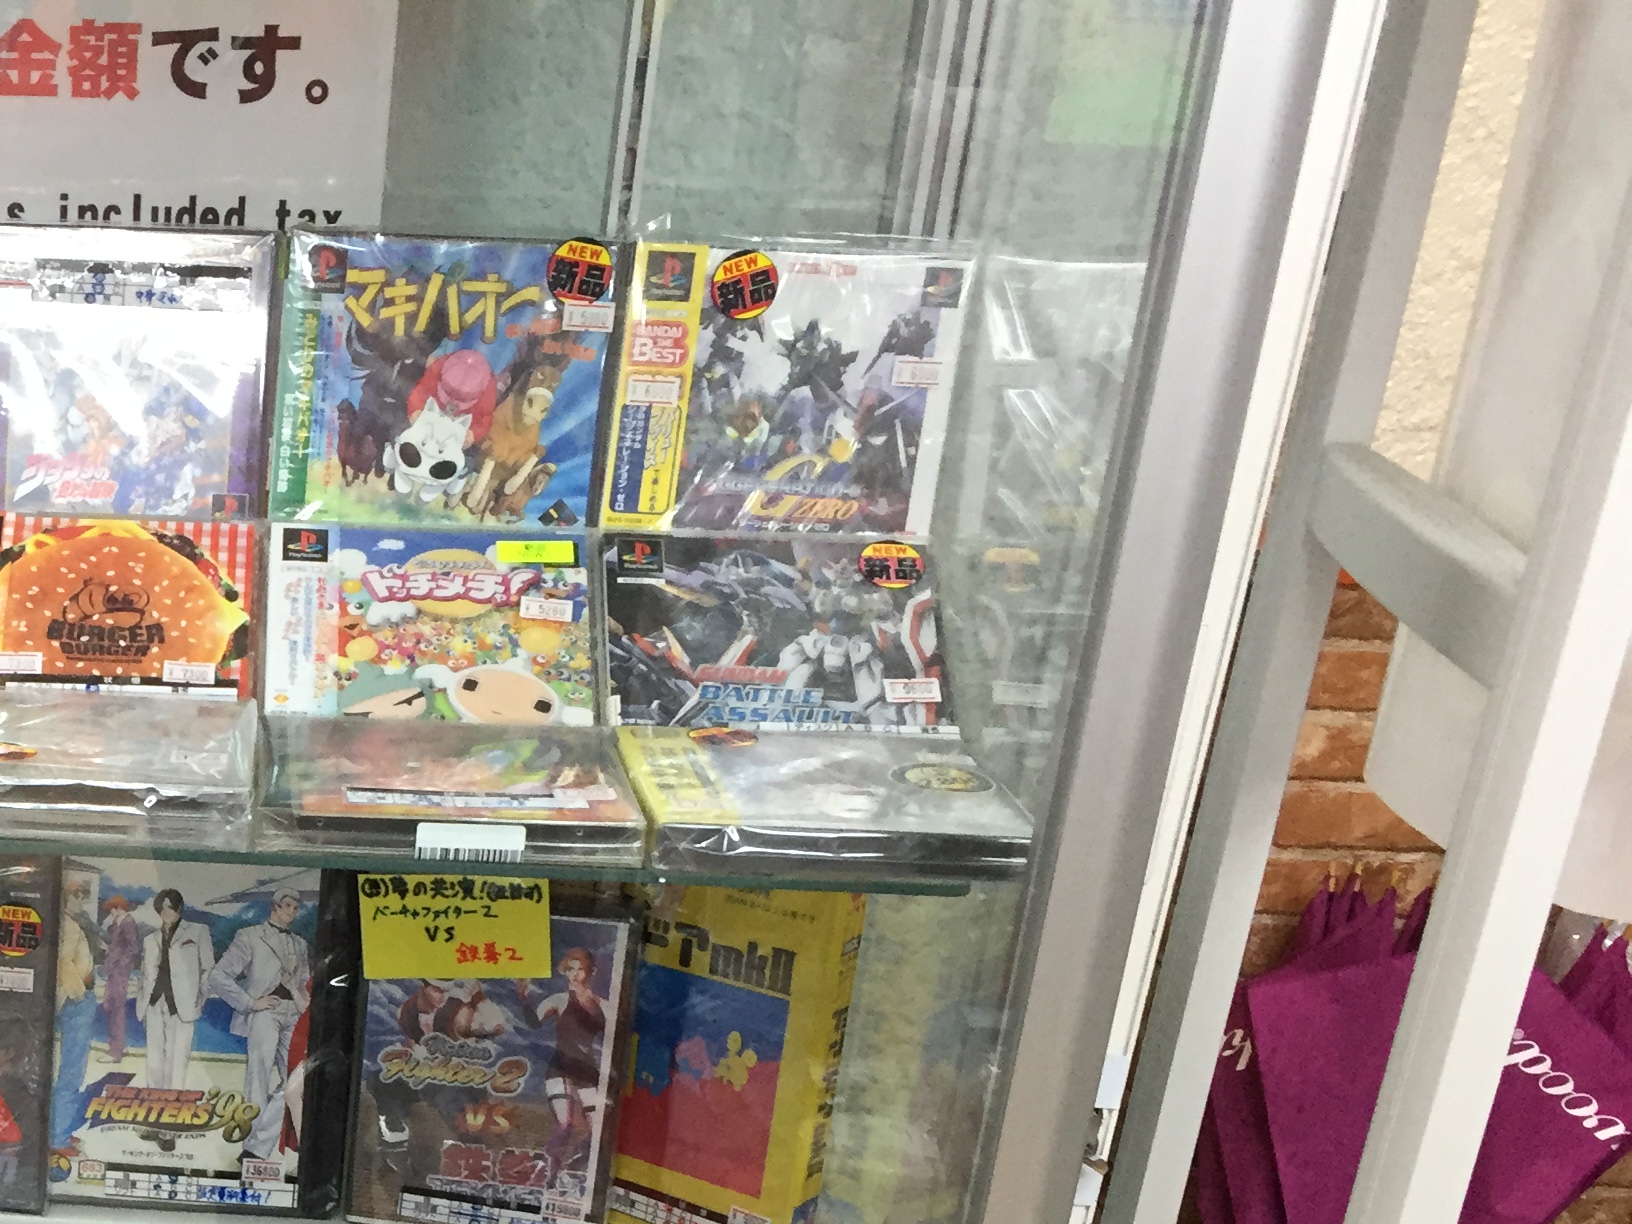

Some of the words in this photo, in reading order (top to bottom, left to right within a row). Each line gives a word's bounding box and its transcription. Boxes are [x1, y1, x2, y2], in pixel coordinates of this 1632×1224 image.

[567, 244, 603, 260] NEW
[721, 254, 760, 277] NEW
[716, 272, 777, 310] 新品
[632, 337, 685, 362] BEST
[872, 545, 909, 556] NEW
[46, 617, 166, 645] BURGER
[698, 683, 824, 702] BATTLE
[701, 702, 856, 724] ASSAULT
[1, 907, 32, 920] NEW
[424, 925, 456, 943] VS
[381, 1049, 496, 1086] Fighter
[84, 1097, 211, 1127] FIGHTERS
